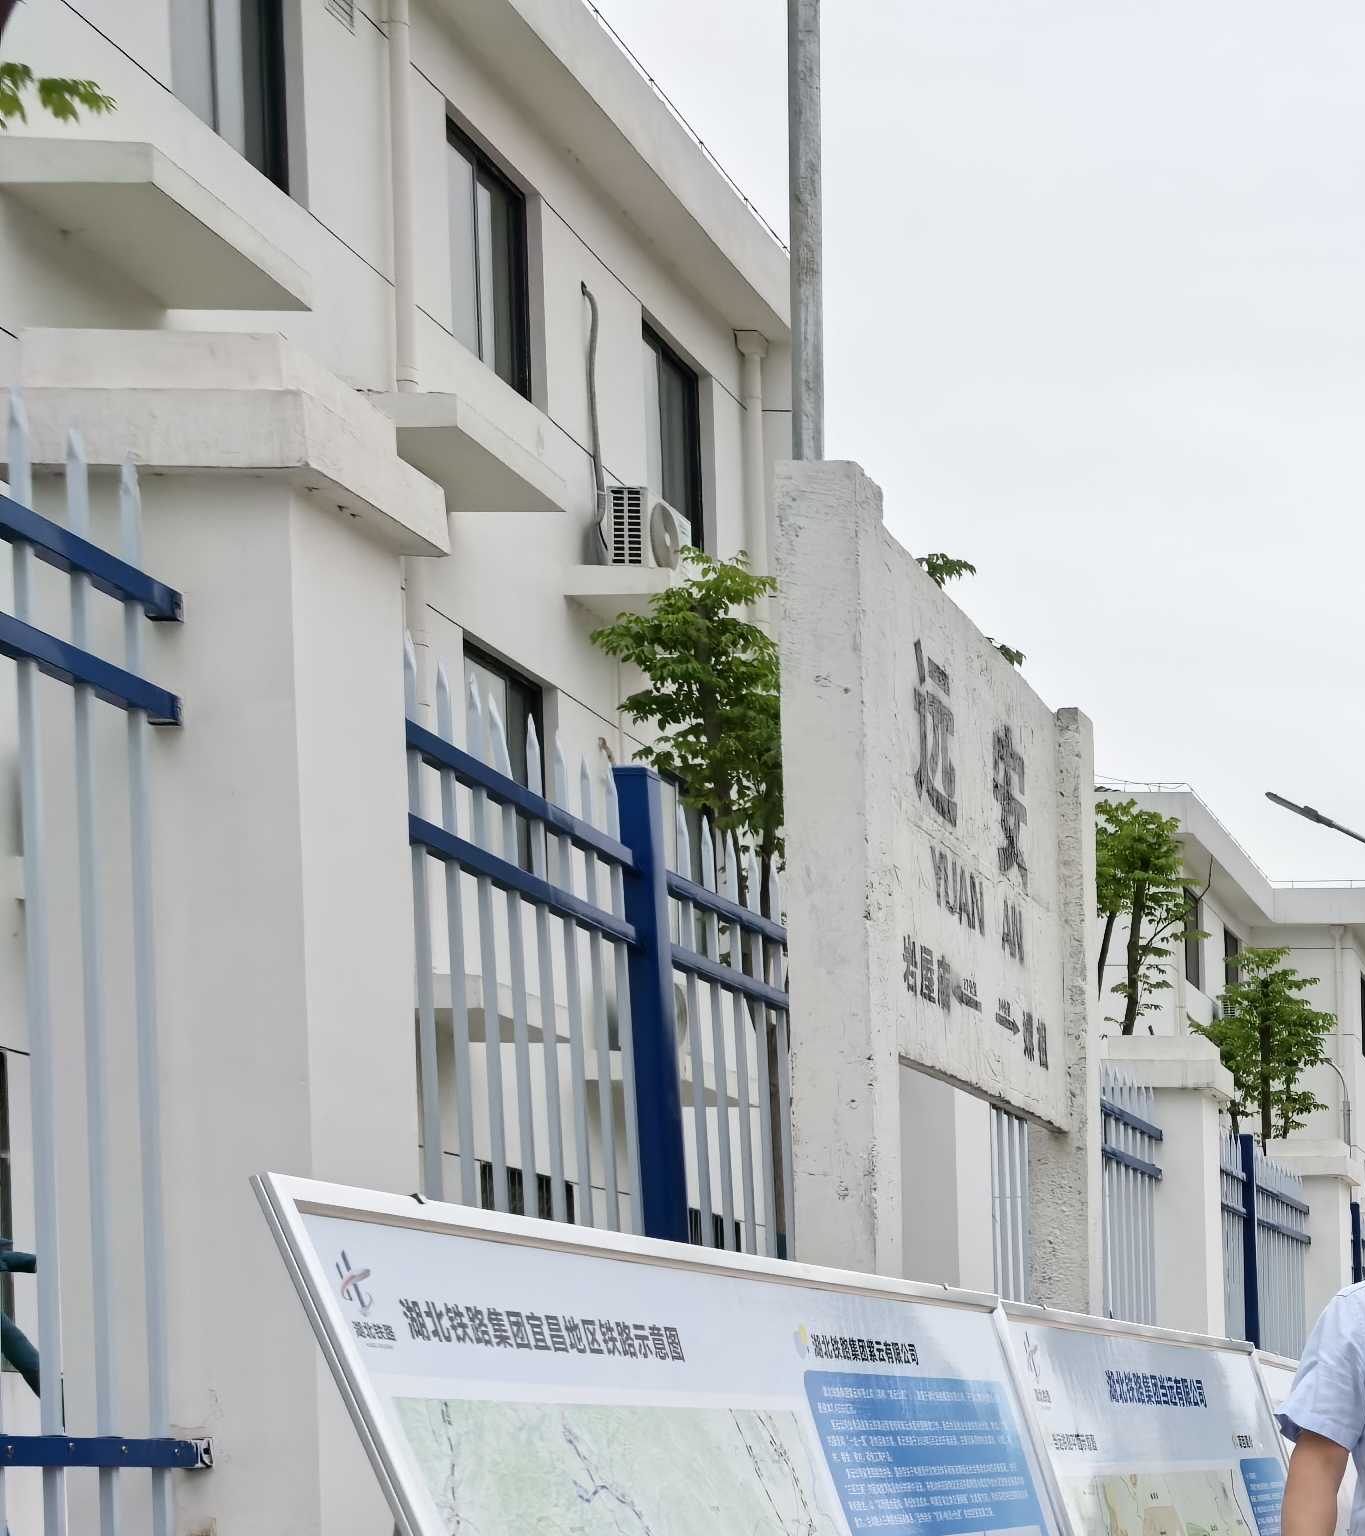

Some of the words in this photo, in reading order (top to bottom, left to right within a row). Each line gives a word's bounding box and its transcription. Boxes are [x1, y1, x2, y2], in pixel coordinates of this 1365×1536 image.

[913, 637, 1028, 898] 远安
[930, 844, 985, 937] YUAN
[1001, 894, 1025, 966] AN
[400, 1298, 686, 1363] 湖北铁路集团宜昌地区铁路示意图
